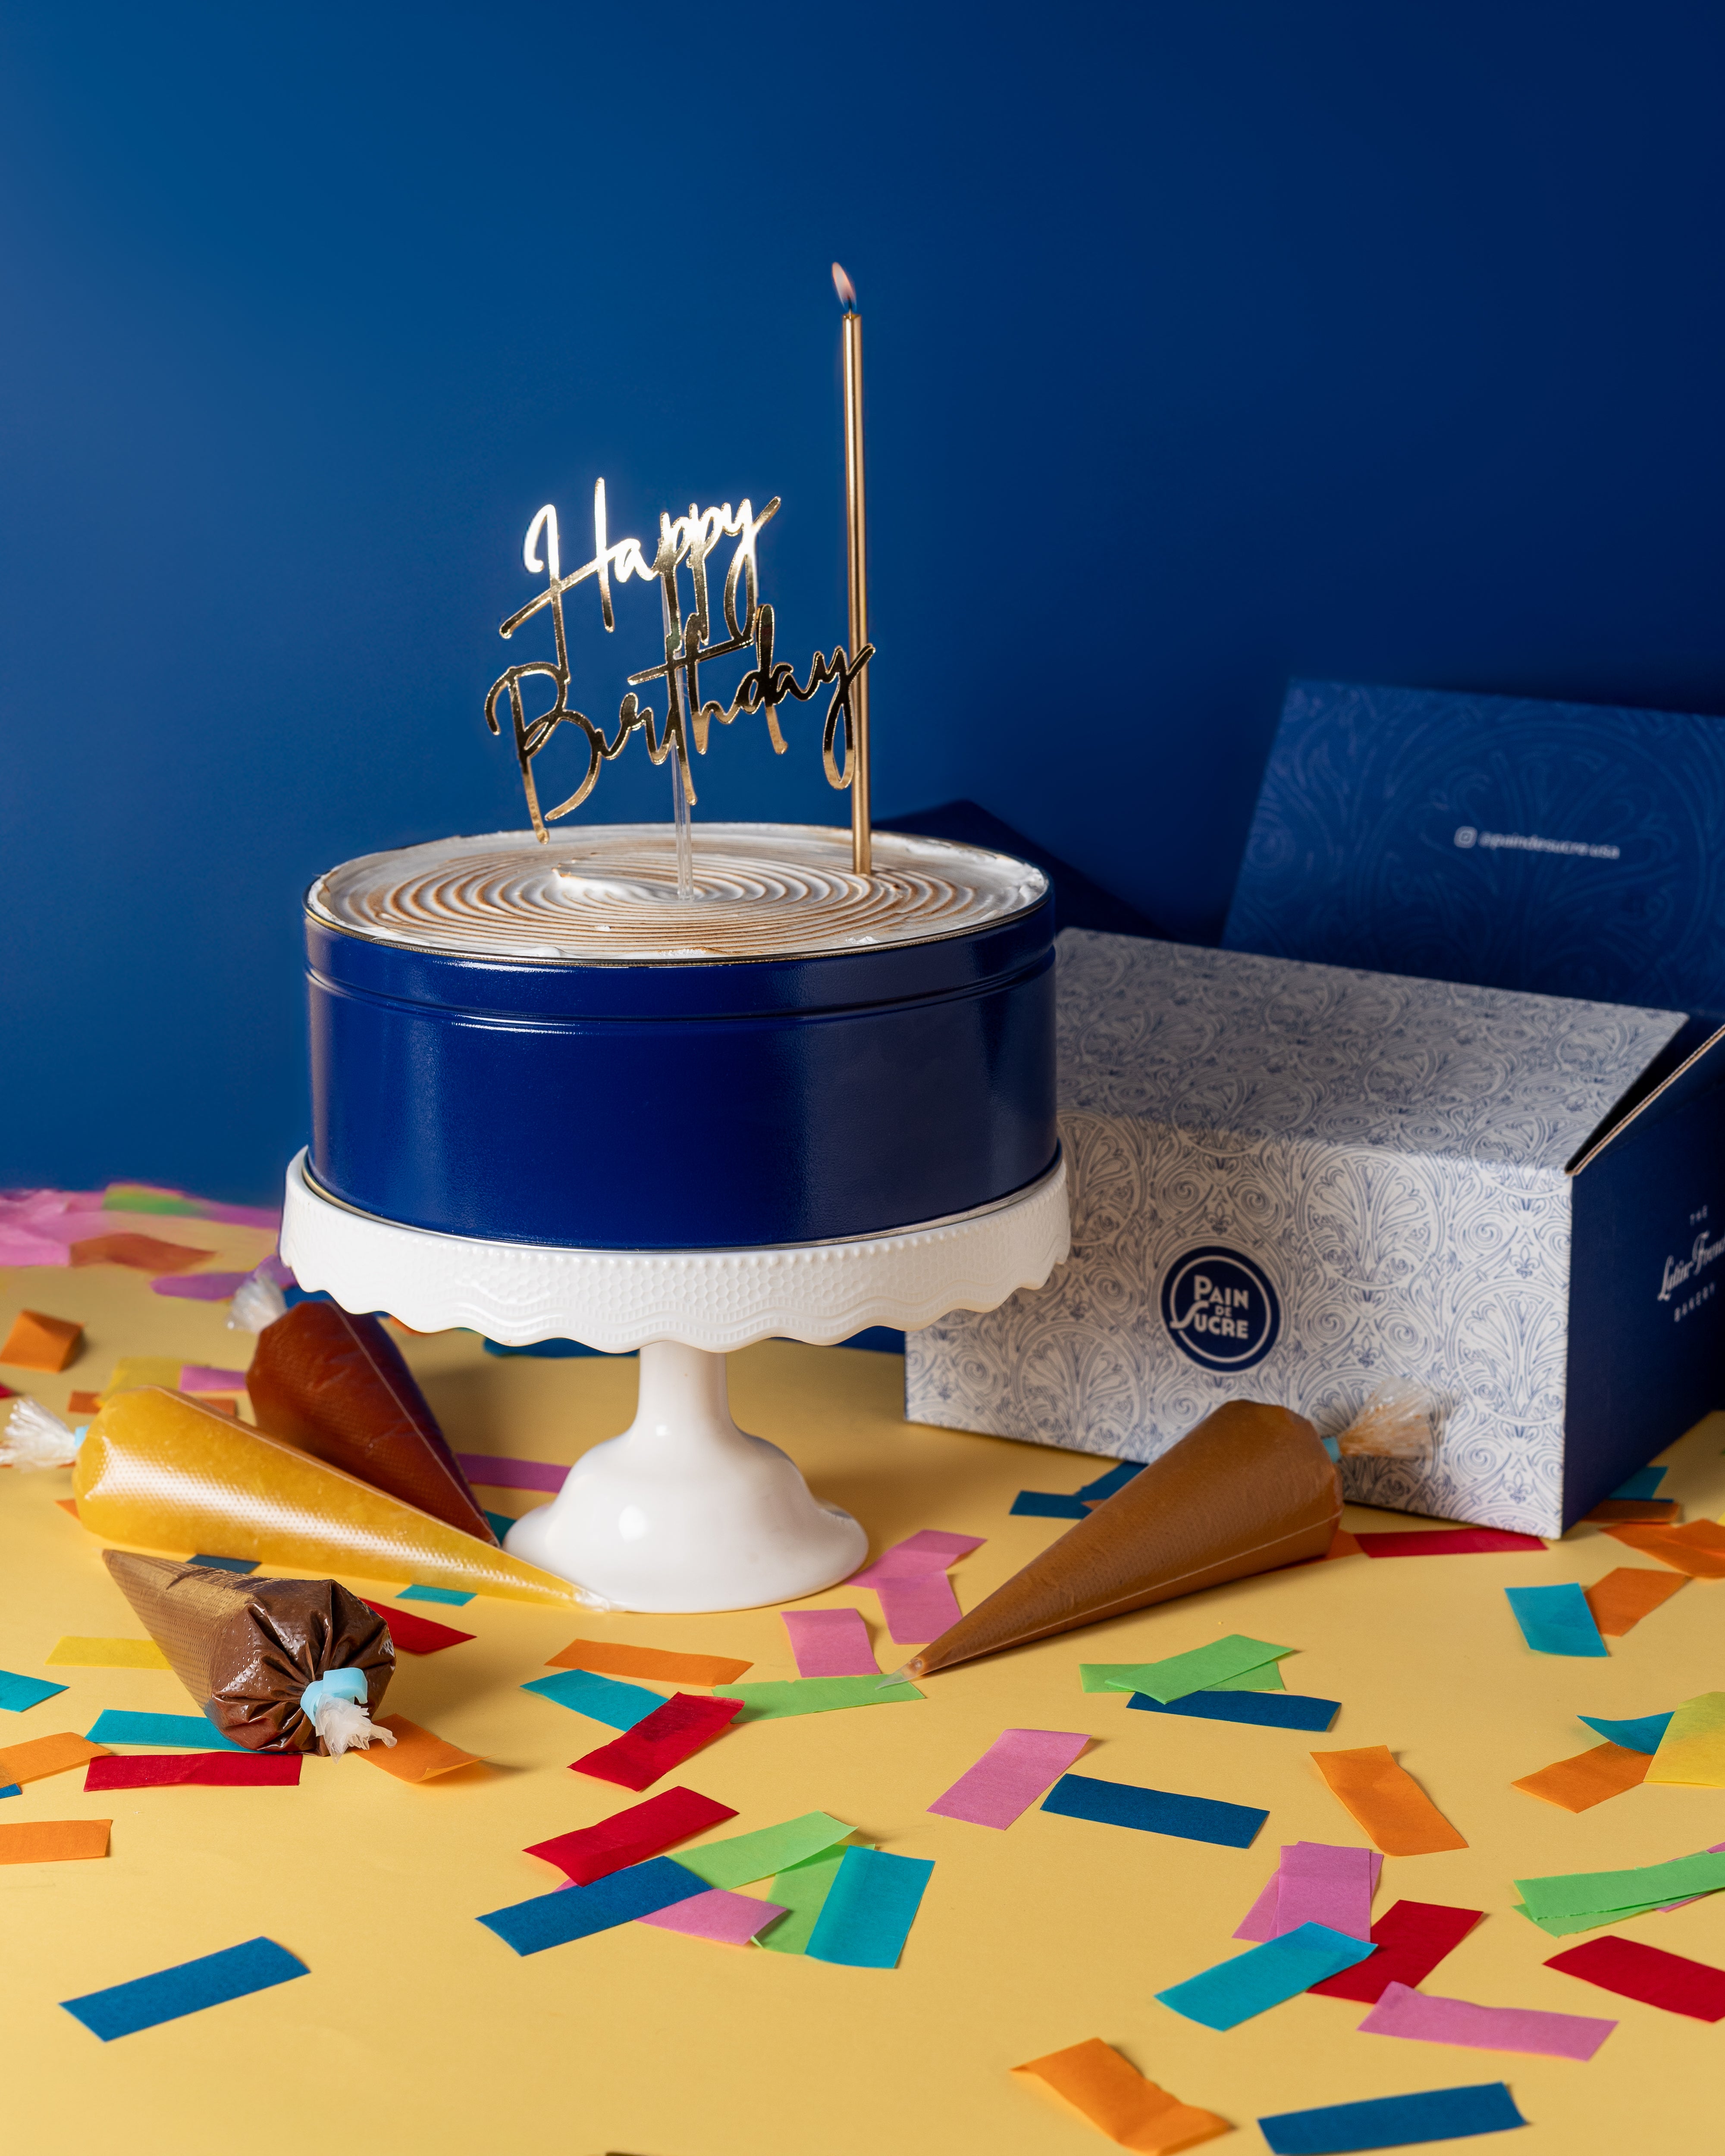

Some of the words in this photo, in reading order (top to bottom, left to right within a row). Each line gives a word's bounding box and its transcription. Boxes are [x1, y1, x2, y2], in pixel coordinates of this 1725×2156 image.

[499, 477, 781, 683] Happy
[484, 604, 876, 844] Birthday
[1194, 1274, 1248, 1310] PAIN
[1657, 1229, 1725, 1301] Latin-Frenc
[1170, 1300, 1248, 1339] SUCRE
[1215, 1305, 1232, 1317] DE
